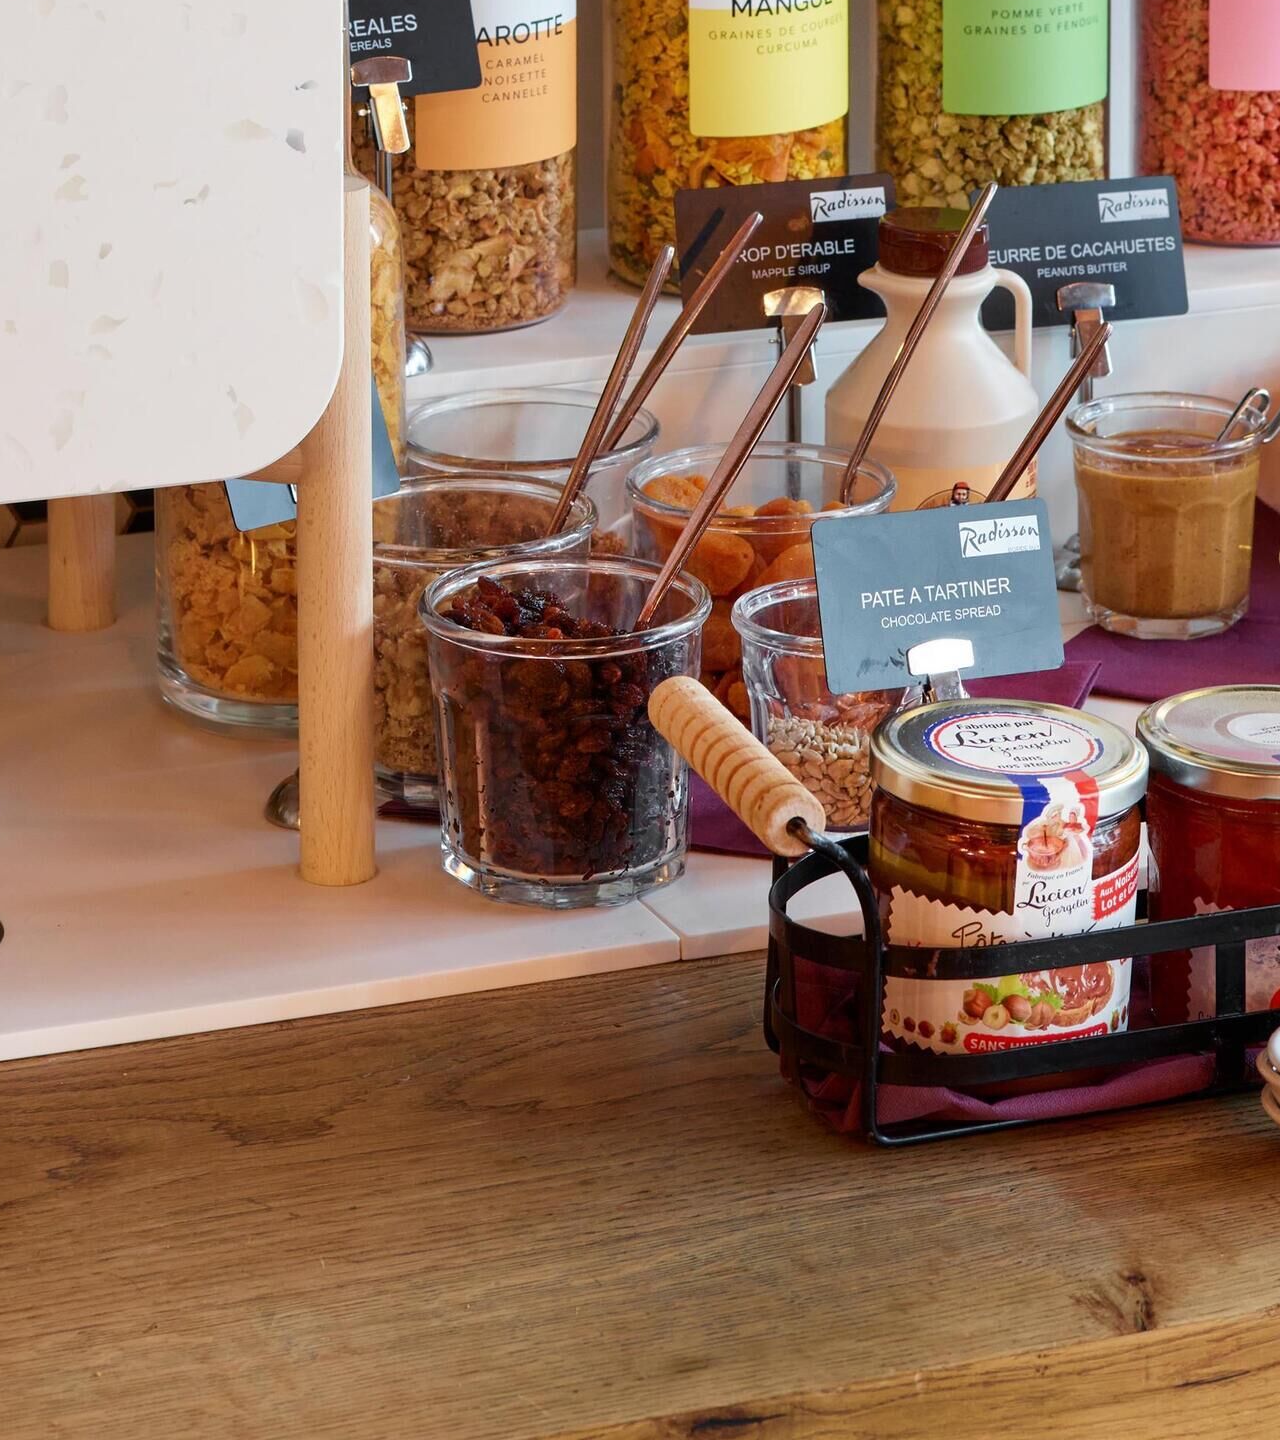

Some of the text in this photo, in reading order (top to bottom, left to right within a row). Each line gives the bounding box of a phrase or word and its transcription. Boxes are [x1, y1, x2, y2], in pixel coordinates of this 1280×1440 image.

[991, 2, 1084, 20] POMME VERTE
[477, 14, 563, 47] AROTTE
[708, 28, 773, 41] GRAINES
[778, 25, 798, 37] DE
[963, 24, 1027, 36] GRAINES
[1033, 23, 1051, 34] DE
[350, 38, 393, 52] EREALS
[756, 38, 818, 56] CURCUMA
[485, 52, 545, 70] CARAMEL
[483, 68, 547, 87] NOISETTE
[481, 84, 549, 104] CANNELLE
[811, 191, 885, 221] Radisson
[1099, 190, 1169, 221] Radisson
[775, 238, 856, 261] D'ERABLE
[988, 236, 1176, 265] EURRE DE CACAHUETES
[751, 263, 831, 280] MAPPLE SIRUP
[1036, 261, 1128, 279] PEANUTS BUTTER
[960, 520, 1039, 558] Radisson
[860, 577, 1011, 609] PATE A TARTINER
[881, 604, 1002, 629] CHOCOLATE SPREAD
[956, 719, 1034, 731] Fabriqué par
[943, 723, 1052, 748] Lucien
[1016, 878, 1088, 910] Lucien
[1100, 885, 1114, 897] Aux
[1101, 891, 1127, 911] Lot et
